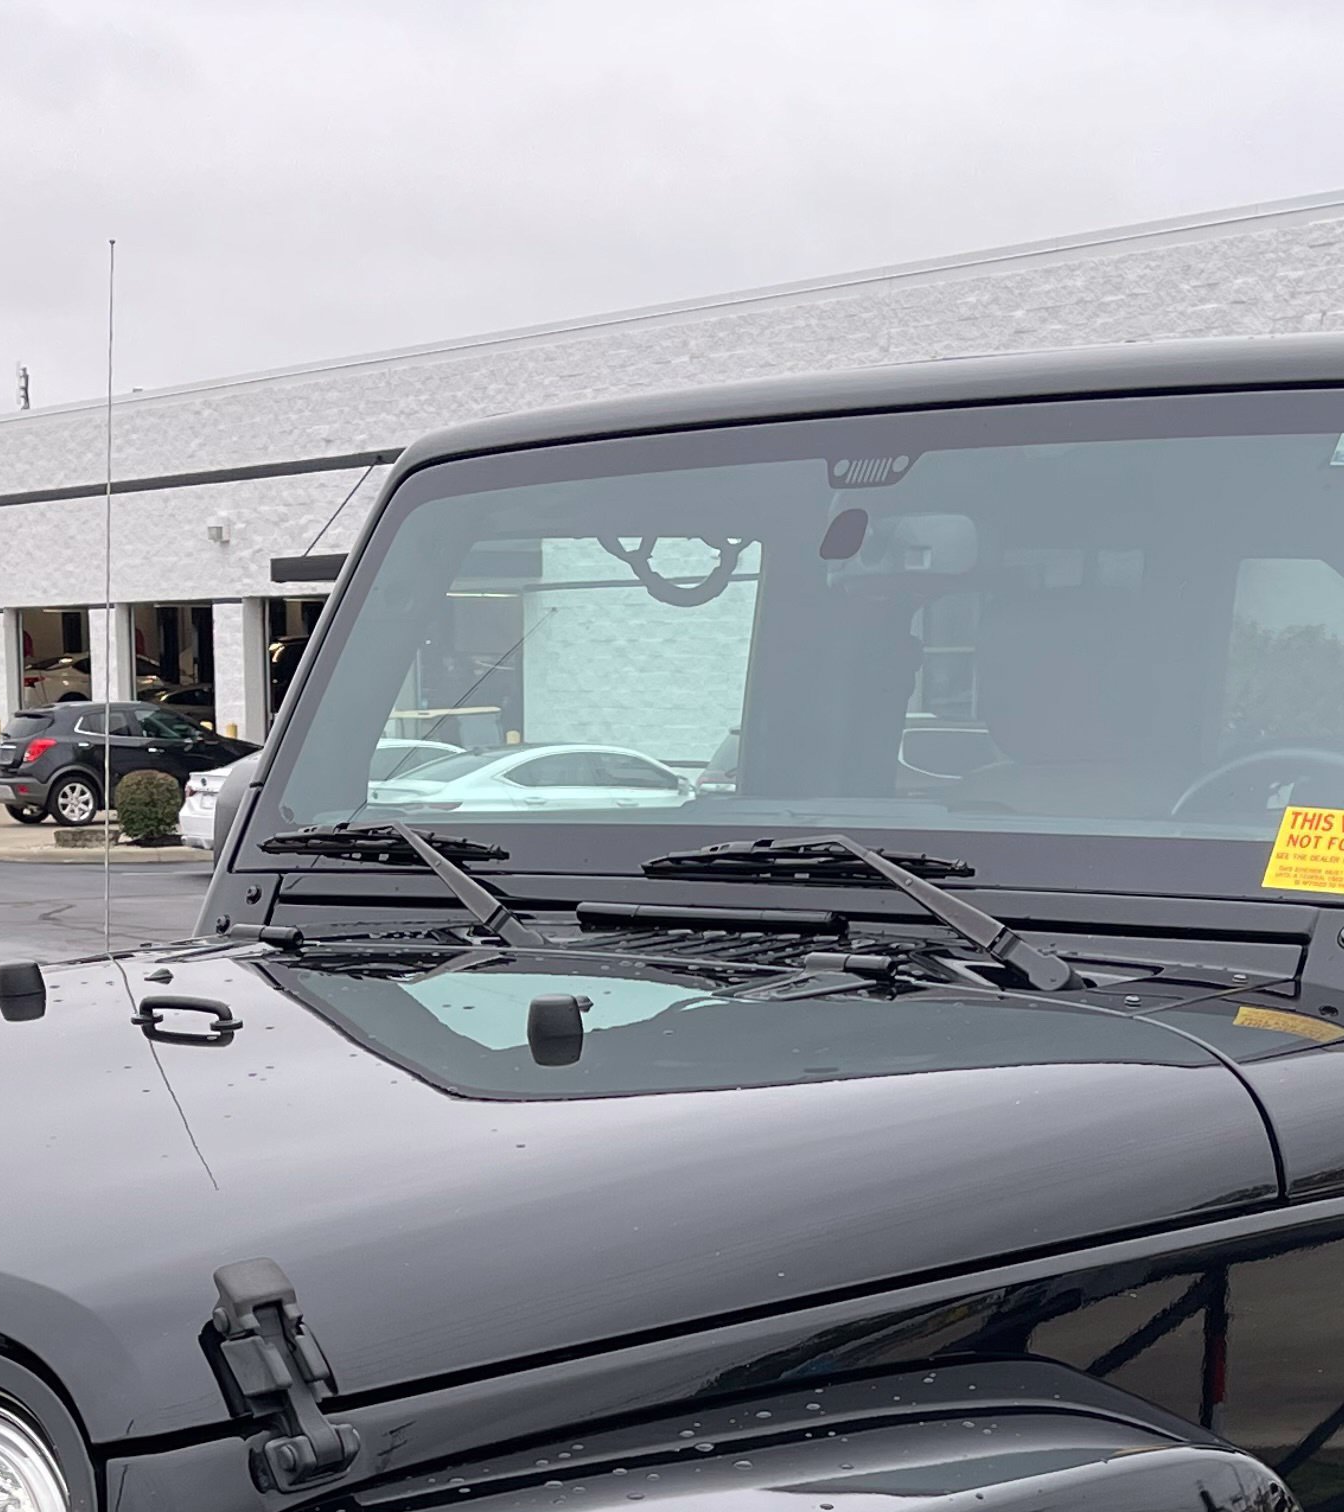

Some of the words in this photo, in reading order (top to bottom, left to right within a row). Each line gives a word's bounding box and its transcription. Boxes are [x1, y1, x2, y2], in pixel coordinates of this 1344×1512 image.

[1290, 811, 1335, 831] THIS
[1287, 834, 1323, 849] NOT
[1293, 853, 1307, 861] THE
[1310, 854, 1340, 864] DEALER
